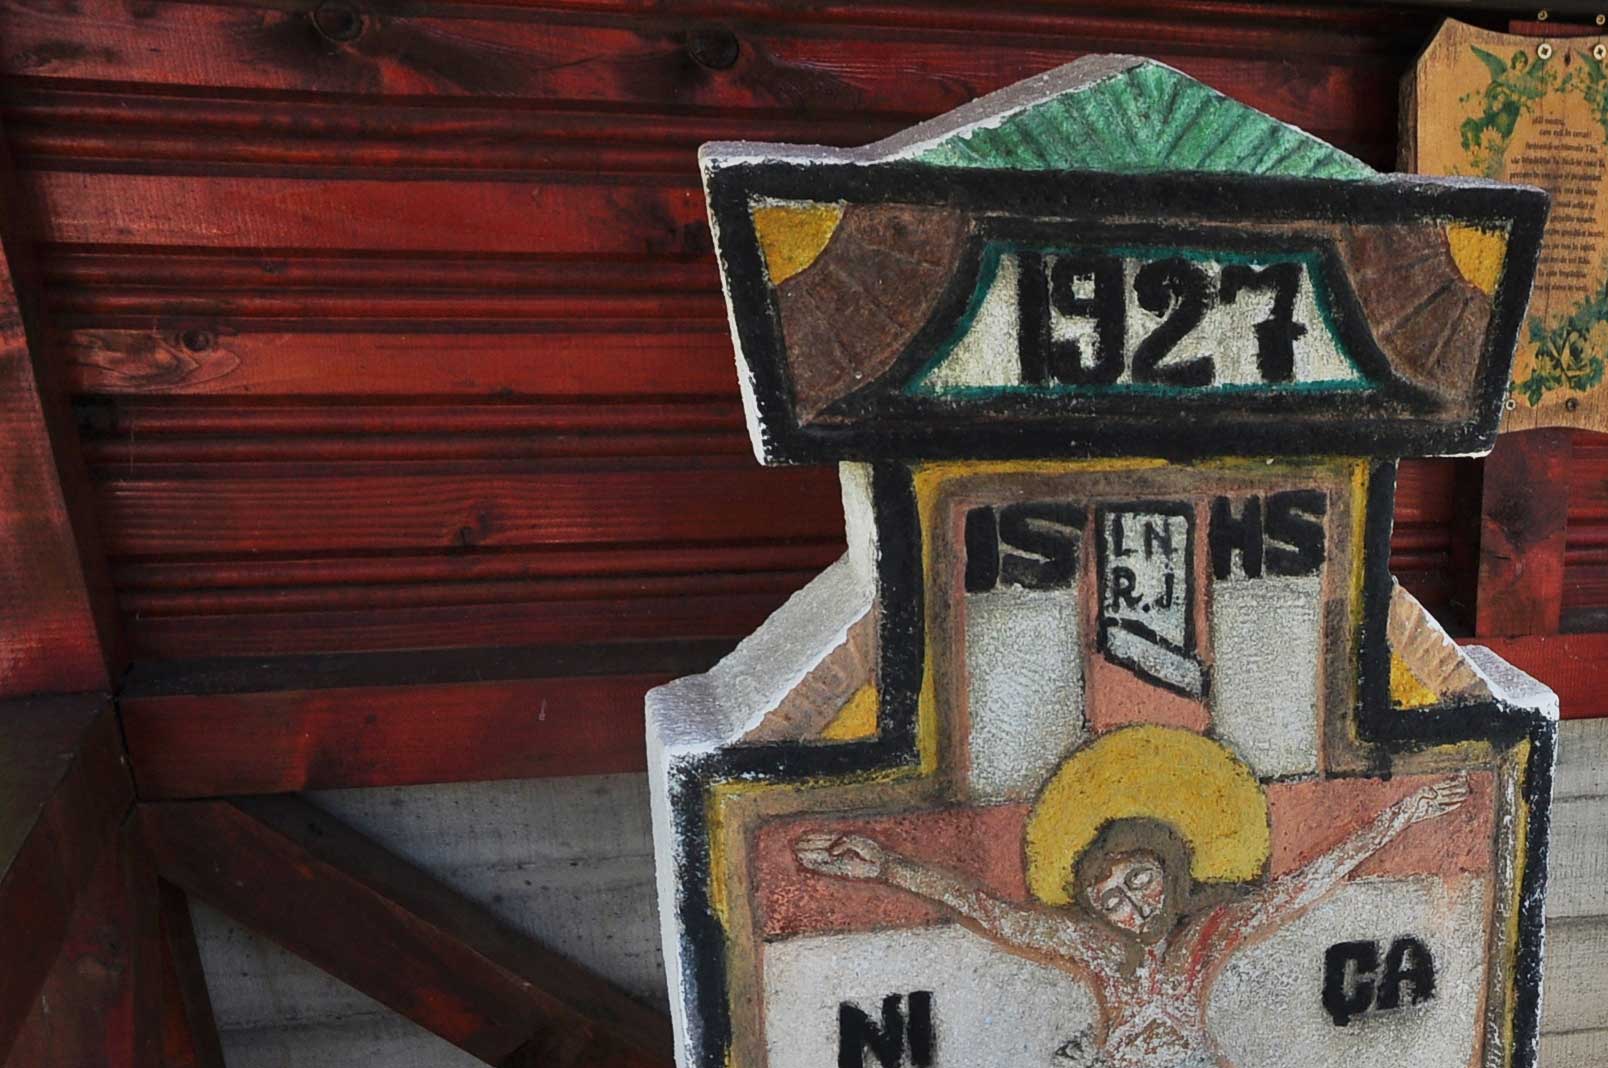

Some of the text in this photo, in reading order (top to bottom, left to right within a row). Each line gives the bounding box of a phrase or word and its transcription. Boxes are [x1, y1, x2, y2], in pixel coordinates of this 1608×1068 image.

[1017, 248, 1303, 387] 1927
[964, 501, 1088, 593] IS
[1210, 489, 1328, 579] HS
